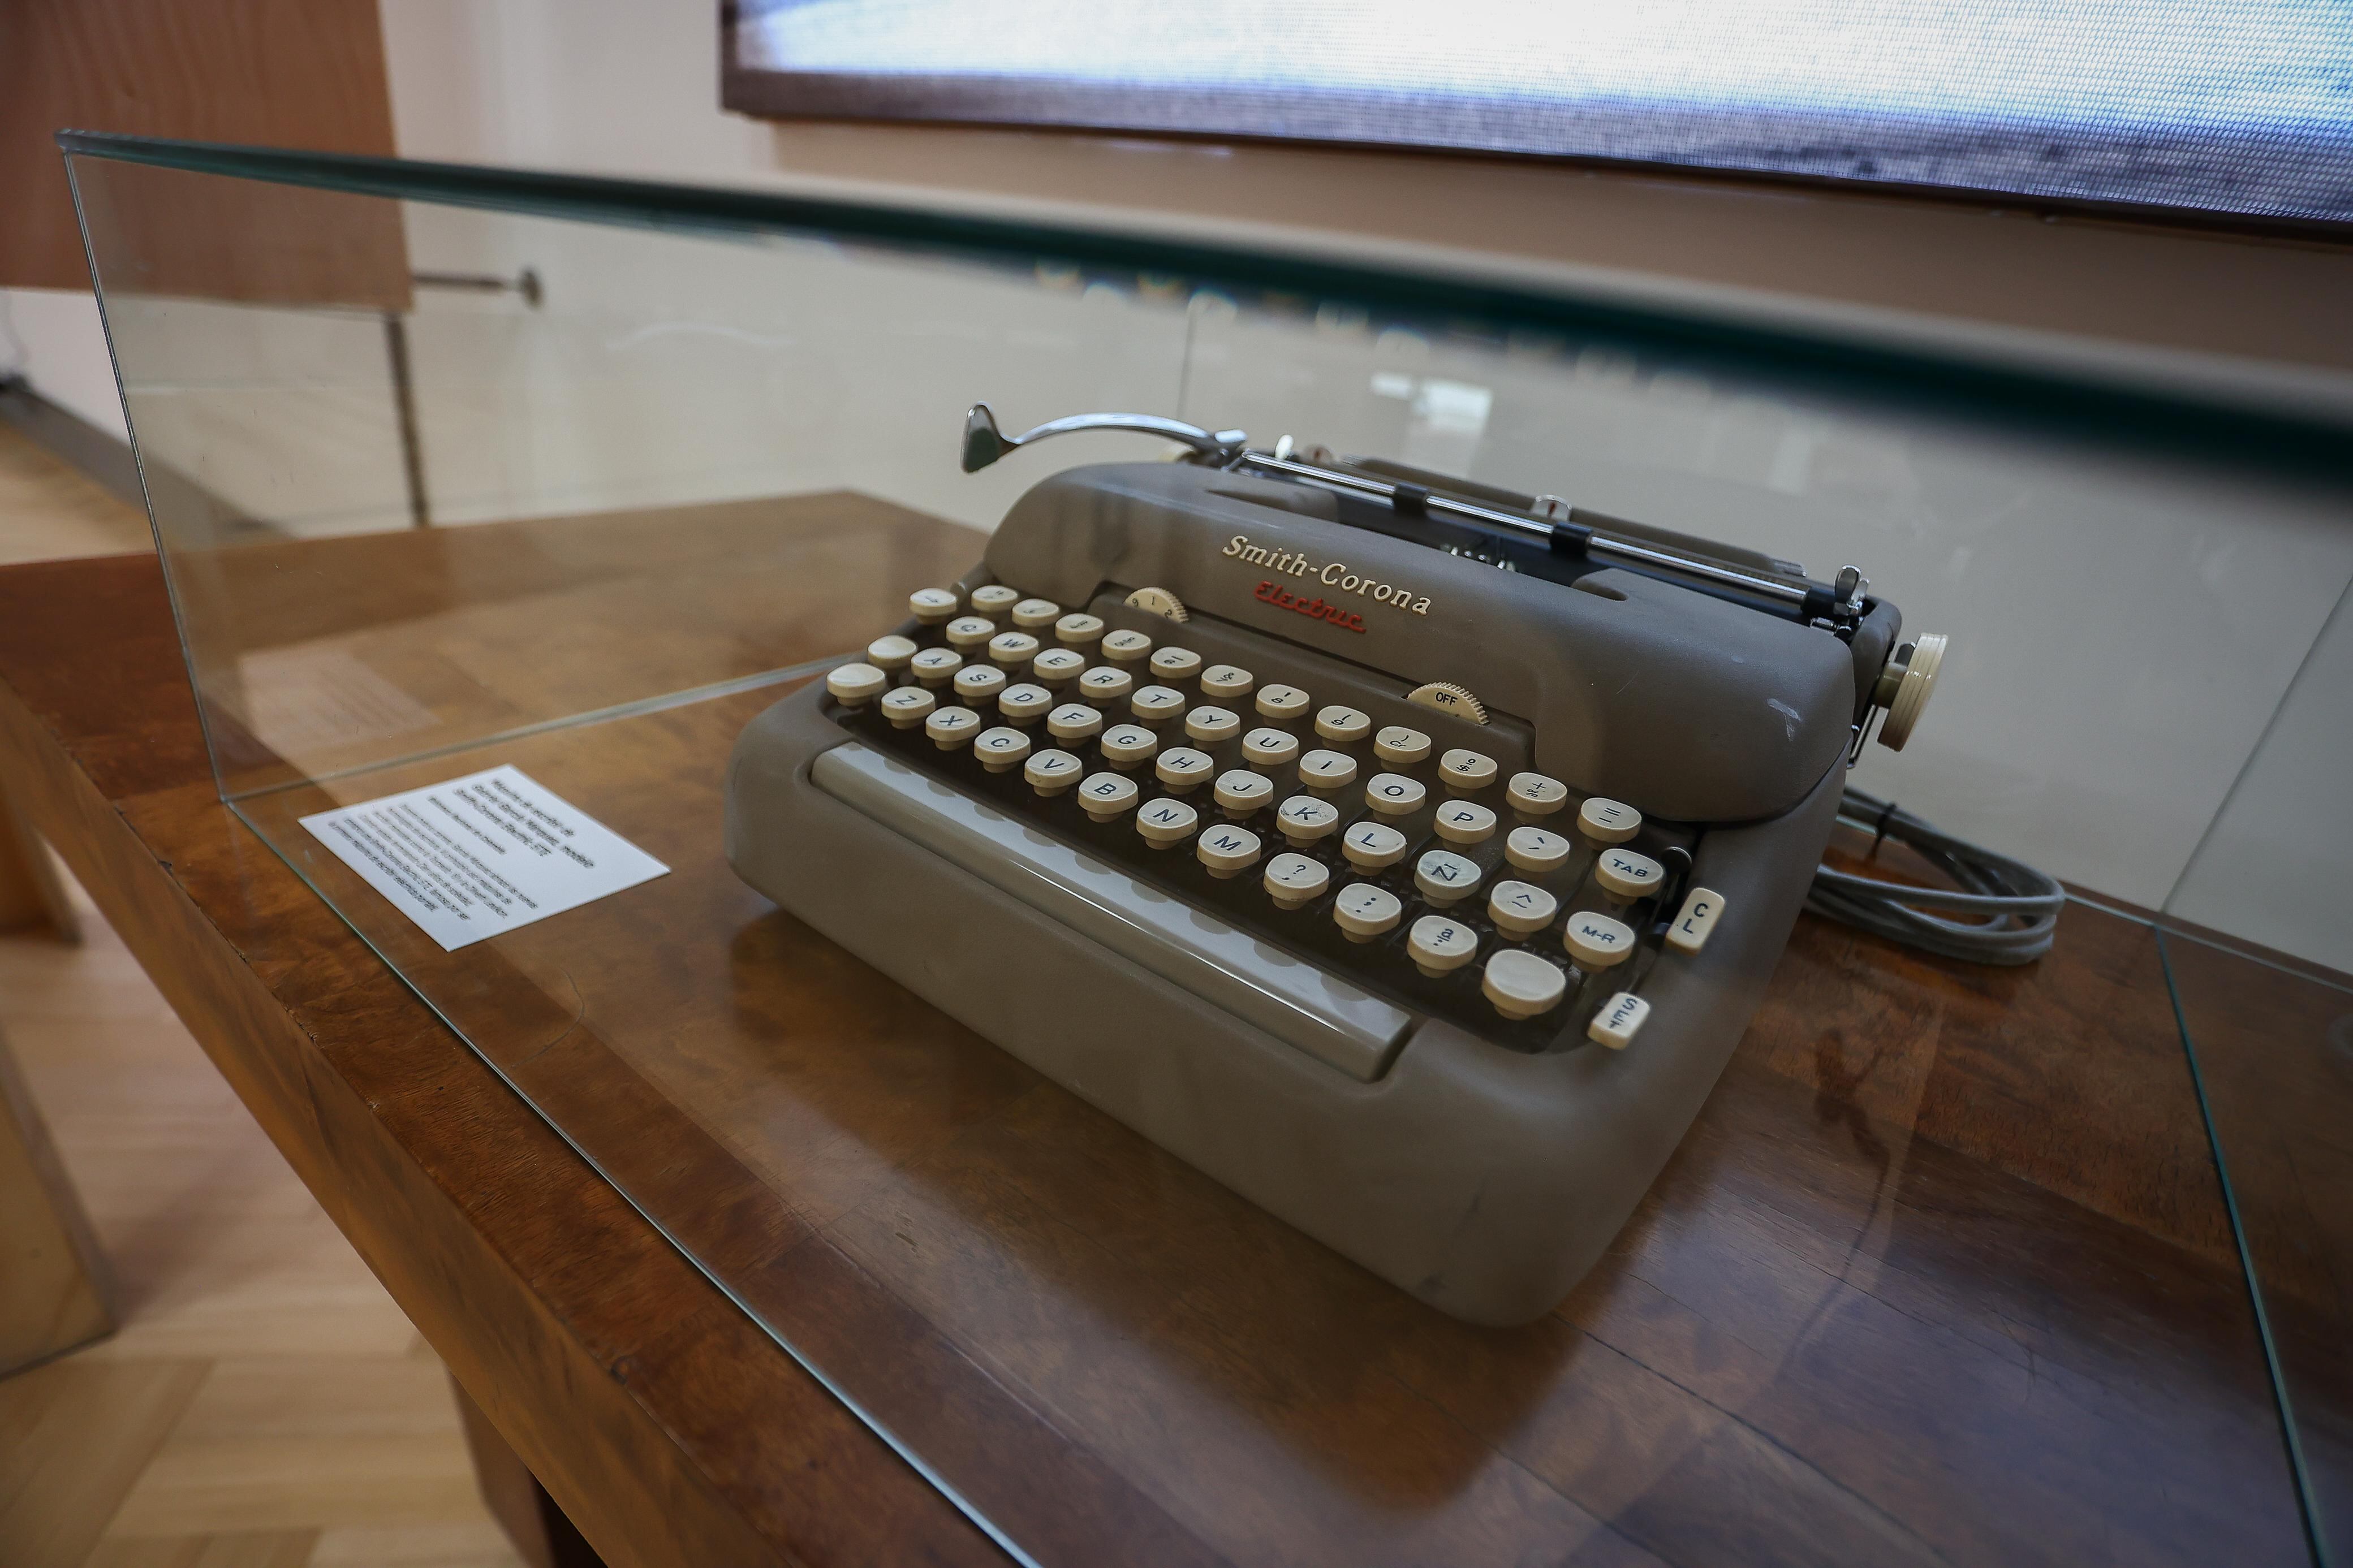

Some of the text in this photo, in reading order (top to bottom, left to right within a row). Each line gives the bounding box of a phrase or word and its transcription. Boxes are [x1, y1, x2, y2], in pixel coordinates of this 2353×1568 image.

[1222, 534, 1432, 616] Smith-Corona
[1252, 580, 1367, 634] Electric
[1046, 655, 1067, 666] E
[969, 673, 988, 683] S
[1093, 674, 1113, 684] R
[895, 695, 917, 705] Z
[1014, 693, 1034, 703] D
[1149, 694, 1168, 704] T
[1435, 692, 1458, 706] OFF
[939, 715, 963, 726] X
[1062, 712, 1084, 721] F
[1204, 715, 1223, 724] Y
[990, 738, 1010, 747] C
[1117, 735, 1137, 745] G
[1259, 737, 1280, 748] U
[1044, 758, 1065, 770] V
[1170, 756, 1195, 769] H
[1094, 782, 1117, 796] B
[1232, 783, 1253, 792] J
[1384, 785, 1404, 796] O
[1152, 809, 1179, 823] N
[1293, 807, 1318, 820] K
[1453, 811, 1474, 822] P
[1213, 835, 1242, 851] M
[1360, 832, 1376, 848] L
[1613, 858, 1648, 877] TAB
[1581, 926, 1615, 944] M-R
[1609, 997, 1637, 1029] SET
